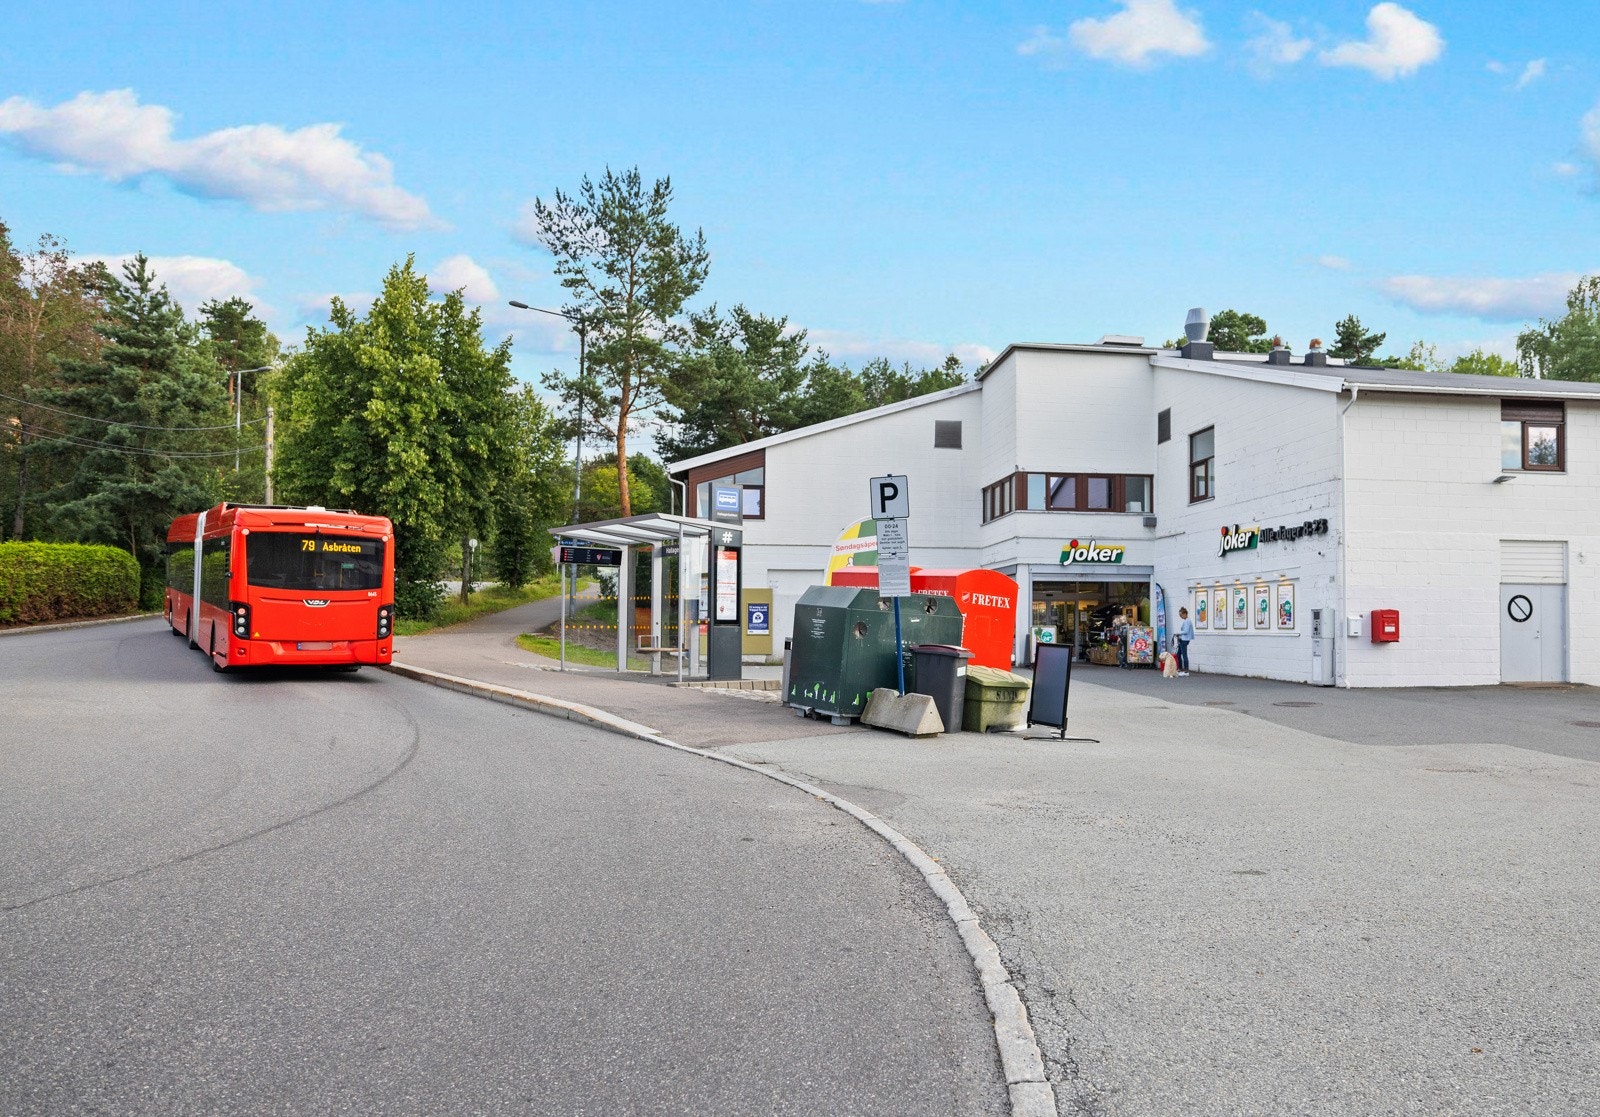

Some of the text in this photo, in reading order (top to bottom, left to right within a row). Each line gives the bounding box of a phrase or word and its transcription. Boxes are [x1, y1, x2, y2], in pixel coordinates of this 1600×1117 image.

[880, 482, 898, 513] P
[1217, 524, 1252, 557] joker
[1259, 528, 1275, 543] Alle
[1276, 526, 1303, 541] dager
[302, 540, 315, 551] 79
[835, 541, 878, 552] Søndagsåpe
[1063, 538, 1122, 566] joker
[972, 592, 1011, 609] FRETEX
